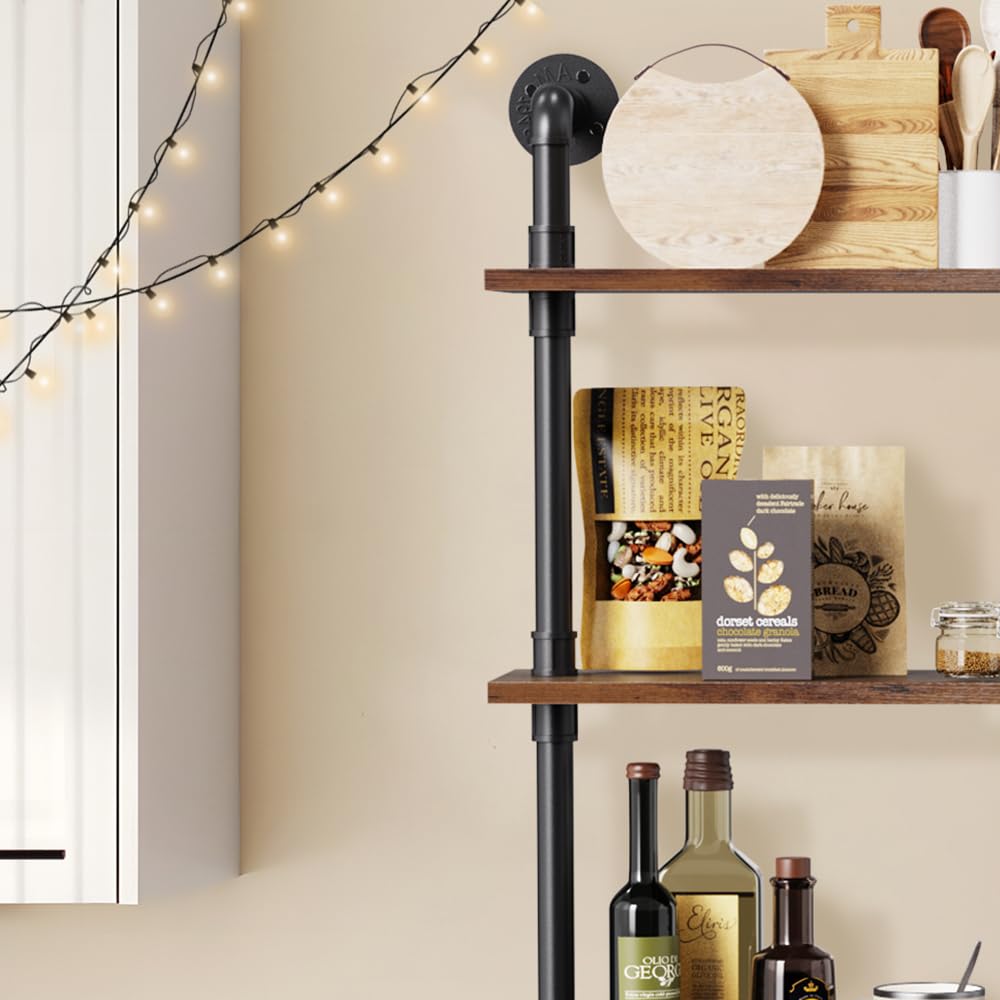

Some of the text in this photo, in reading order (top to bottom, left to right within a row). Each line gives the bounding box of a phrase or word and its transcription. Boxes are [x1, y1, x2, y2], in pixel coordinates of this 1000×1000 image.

[668, 423, 676, 433] of
[716, 386, 732, 478] RGAN
[649, 432, 657, 448] that
[668, 438, 676, 452] the
[649, 452, 657, 466] has
[658, 451, 666, 484] climate
[677, 470, 685, 512] character
[658, 495, 666, 512] and
[814, 586, 858, 598] BREAD
[716, 615, 798, 627] dorset cereals
[716, 627, 800, 639] chocolate granola
[642, 955, 669, 965] OLIO
